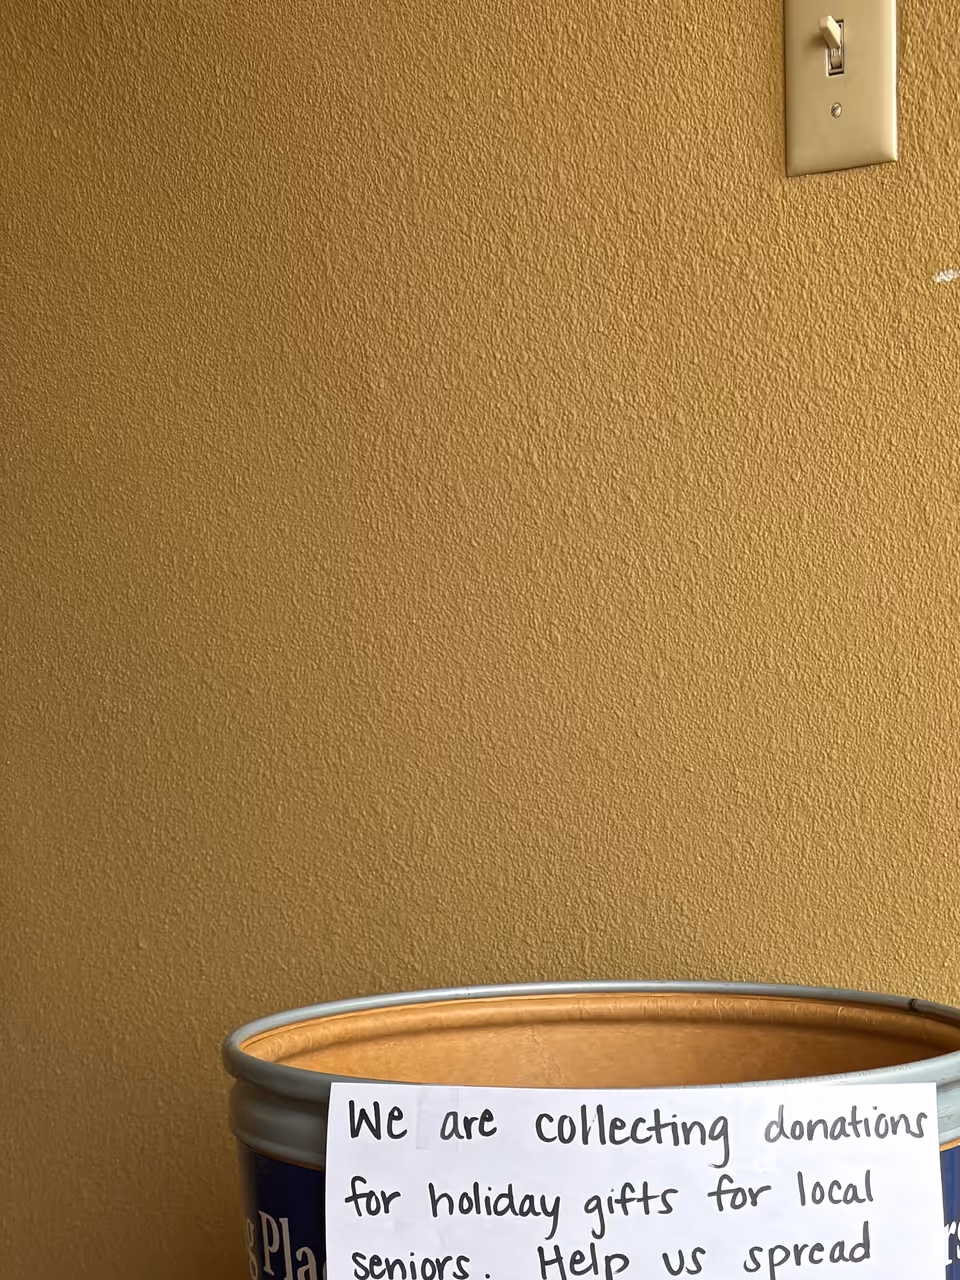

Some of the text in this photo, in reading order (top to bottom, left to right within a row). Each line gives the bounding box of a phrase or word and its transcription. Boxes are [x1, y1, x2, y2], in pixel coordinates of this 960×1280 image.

[348, 1099, 928, 1169] We are collecting donations
[344, 1169, 874, 1241] for holiday gifts for local
[661, 1246, 706, 1276] us
